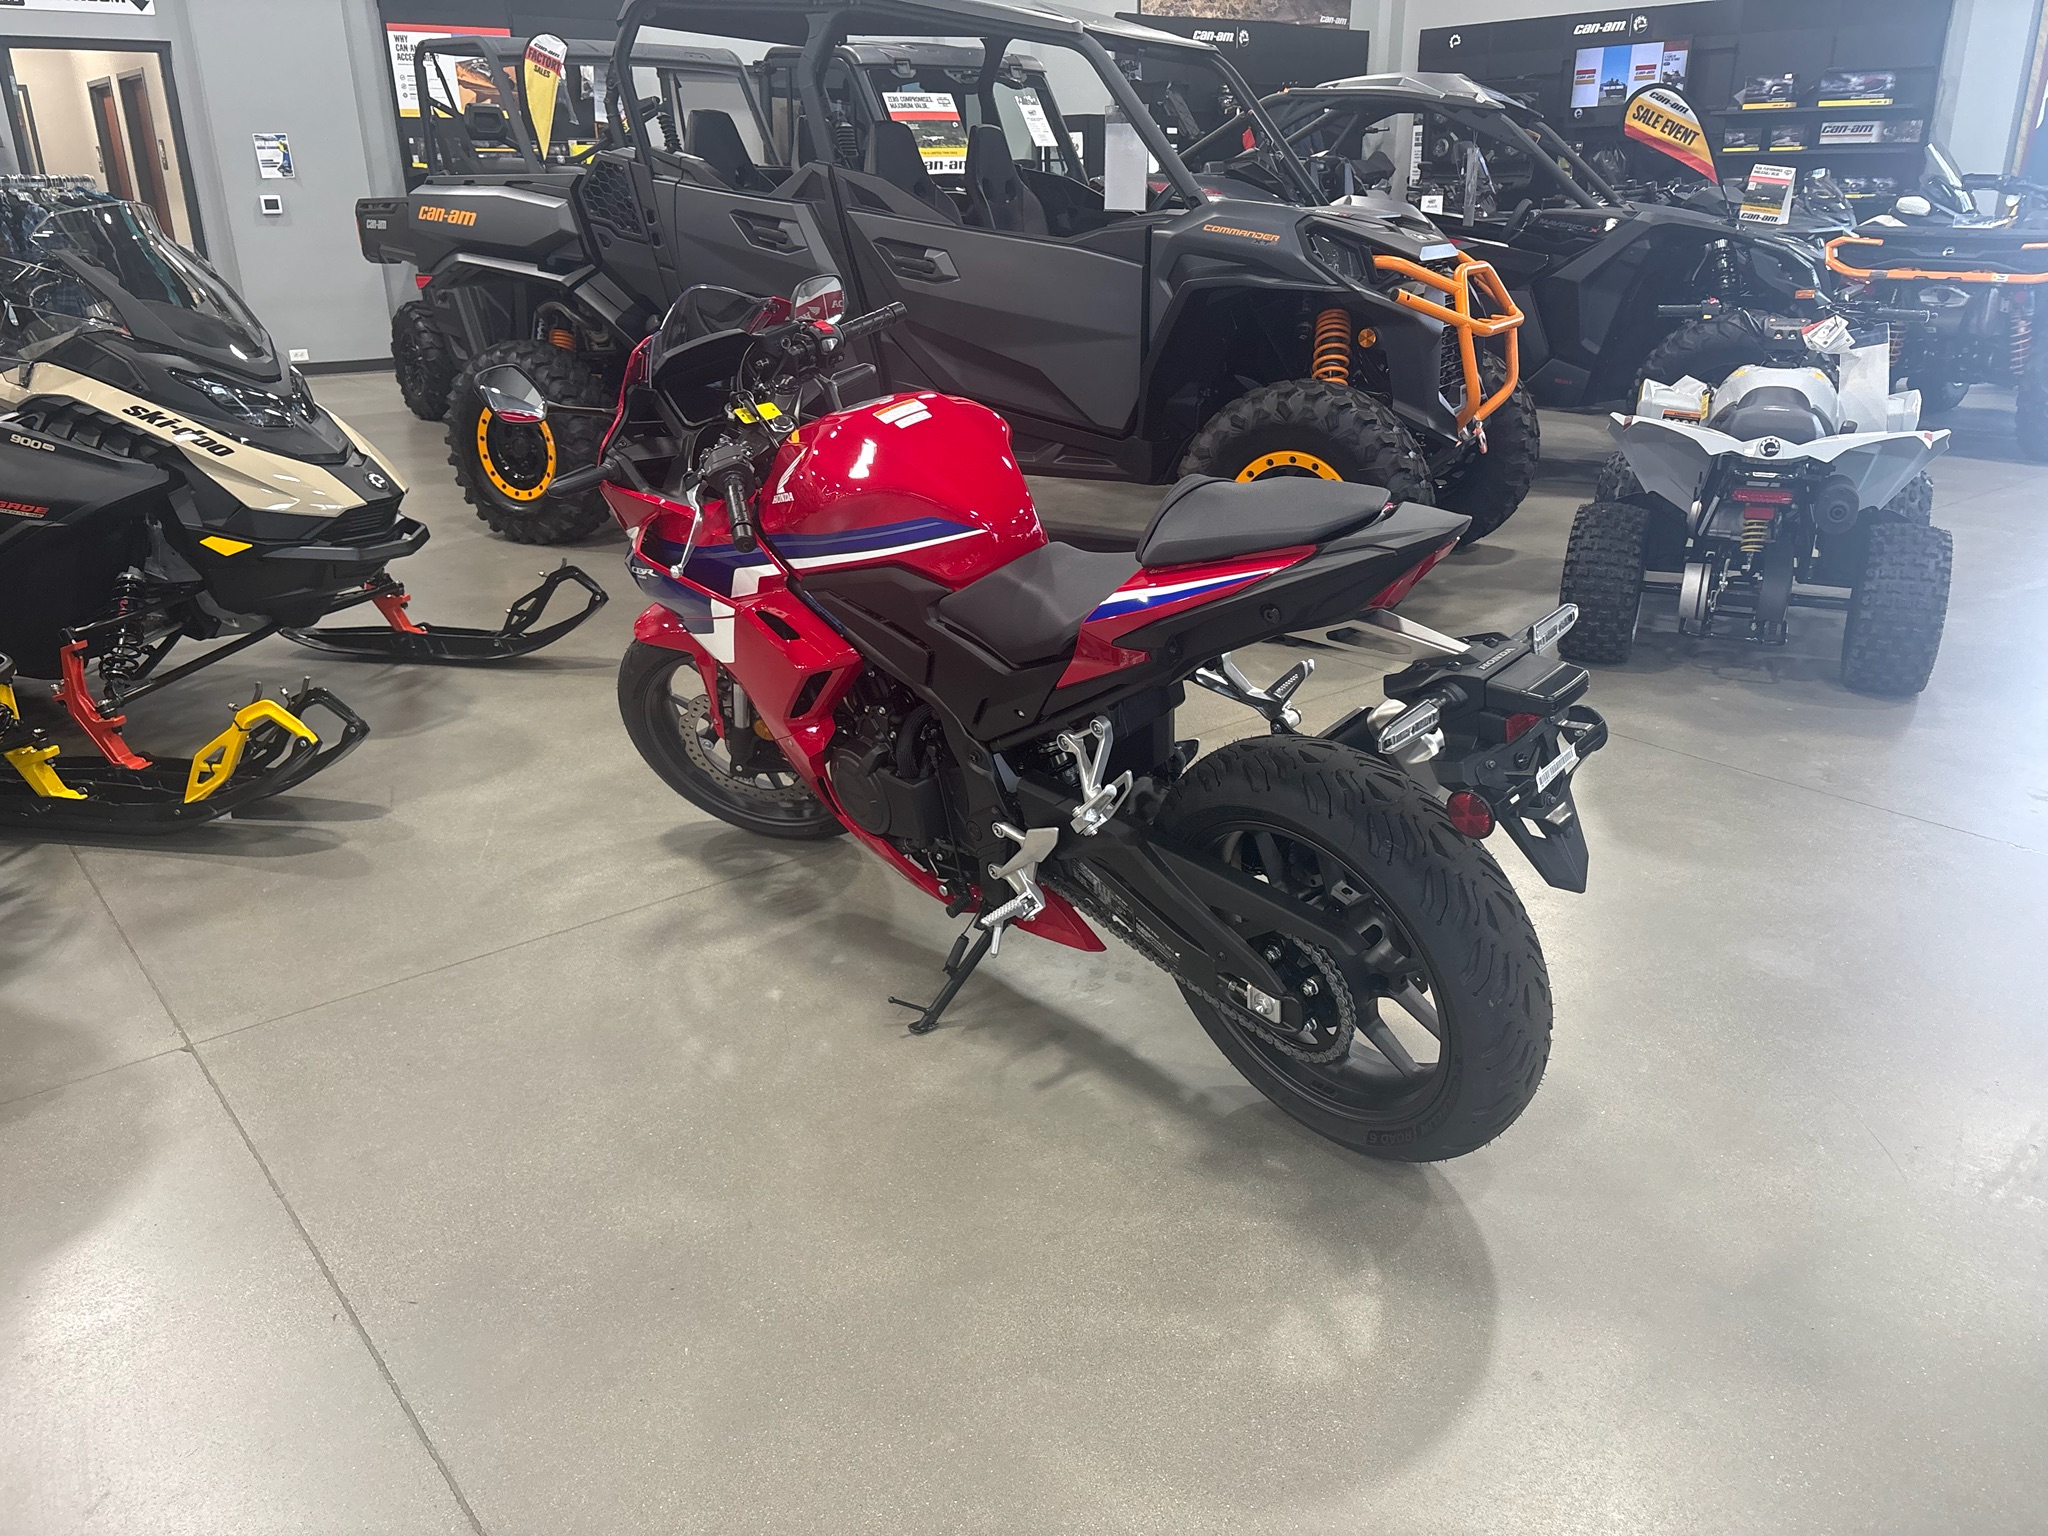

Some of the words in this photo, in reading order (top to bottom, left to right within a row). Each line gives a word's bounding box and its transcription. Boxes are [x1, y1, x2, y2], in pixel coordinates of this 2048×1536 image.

[1320, 15, 1347, 25] can-am
[1573, 20, 1627, 35] can-am
[394, 34, 408, 43] WHY
[1193, 29, 1234, 42] can-am
[534, 43, 560, 58] can-am
[533, 64, 550, 78] SALES
[1649, 91, 1689, 114] can-am
[1632, 104, 1664, 130] SALE
[1660, 118, 1700, 146] EVENT
[1821, 124, 1874, 134] can-am
[924, 160, 966, 170] an-a
[418, 205, 477, 226] can-am
[1741, 212, 1779, 222] can-am
[366, 219, 386, 229] can-am
[1538, 219, 1589, 232] MAVERICK
[1203, 224, 1280, 242] COMMANDER
[122, 405, 235, 457] ski-doo
[10, 433, 43, 450] 900
[772, 492, 795, 504] HONDA
[1477, 647, 1516, 670] HONDA
